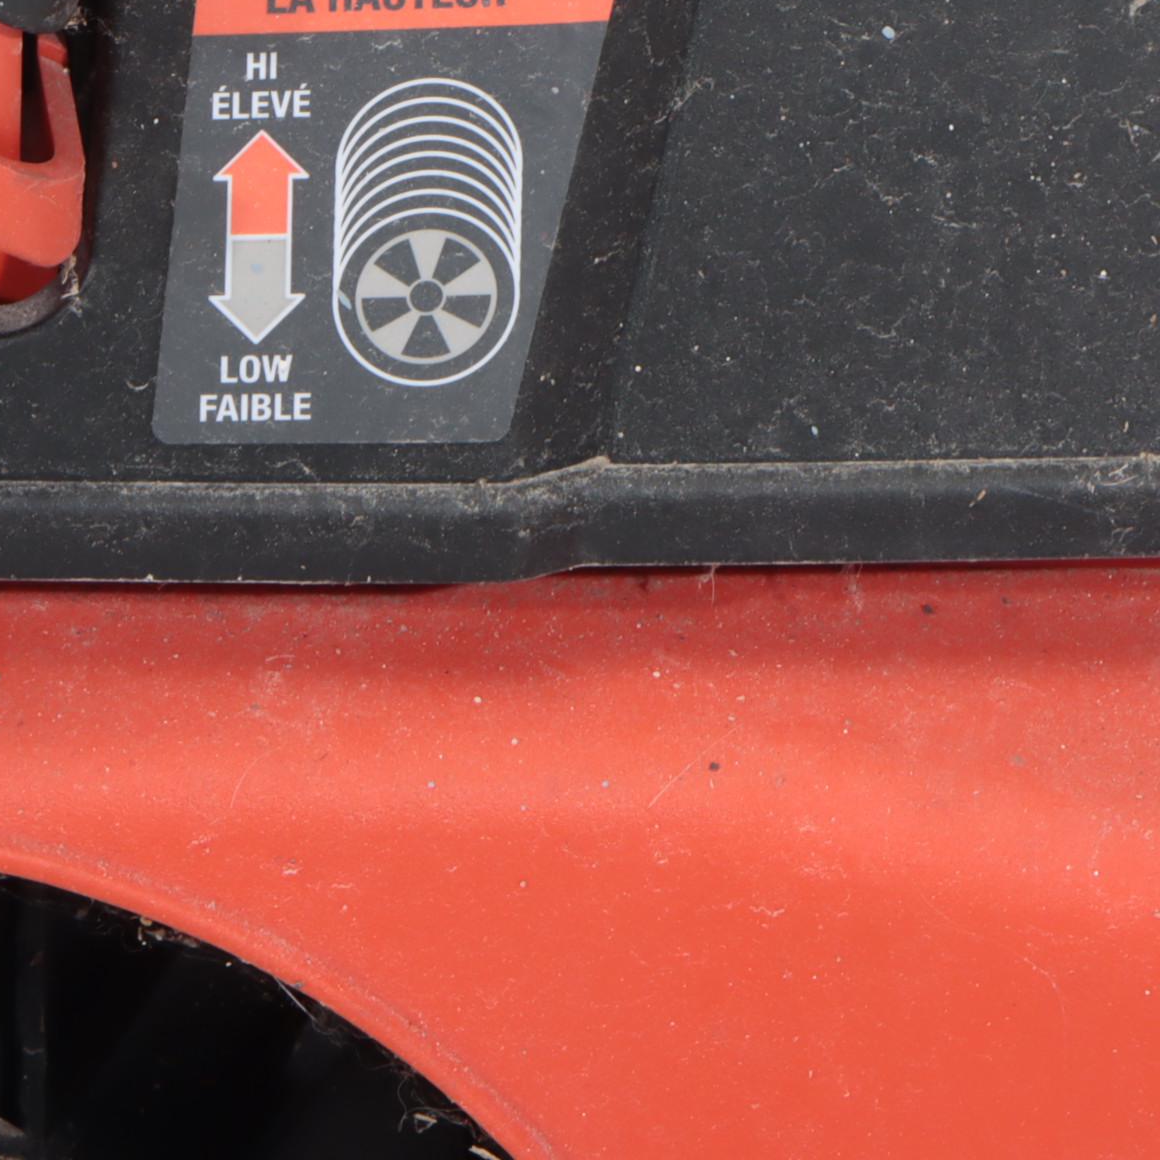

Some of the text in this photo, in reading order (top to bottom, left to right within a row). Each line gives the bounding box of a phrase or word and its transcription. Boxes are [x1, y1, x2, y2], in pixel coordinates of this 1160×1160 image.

[246, 52, 277, 80] HI
[212, 84, 312, 119] ÉLEVÉ
[219, 354, 293, 383] LOW
[198, 393, 312, 422] FAIBLE
